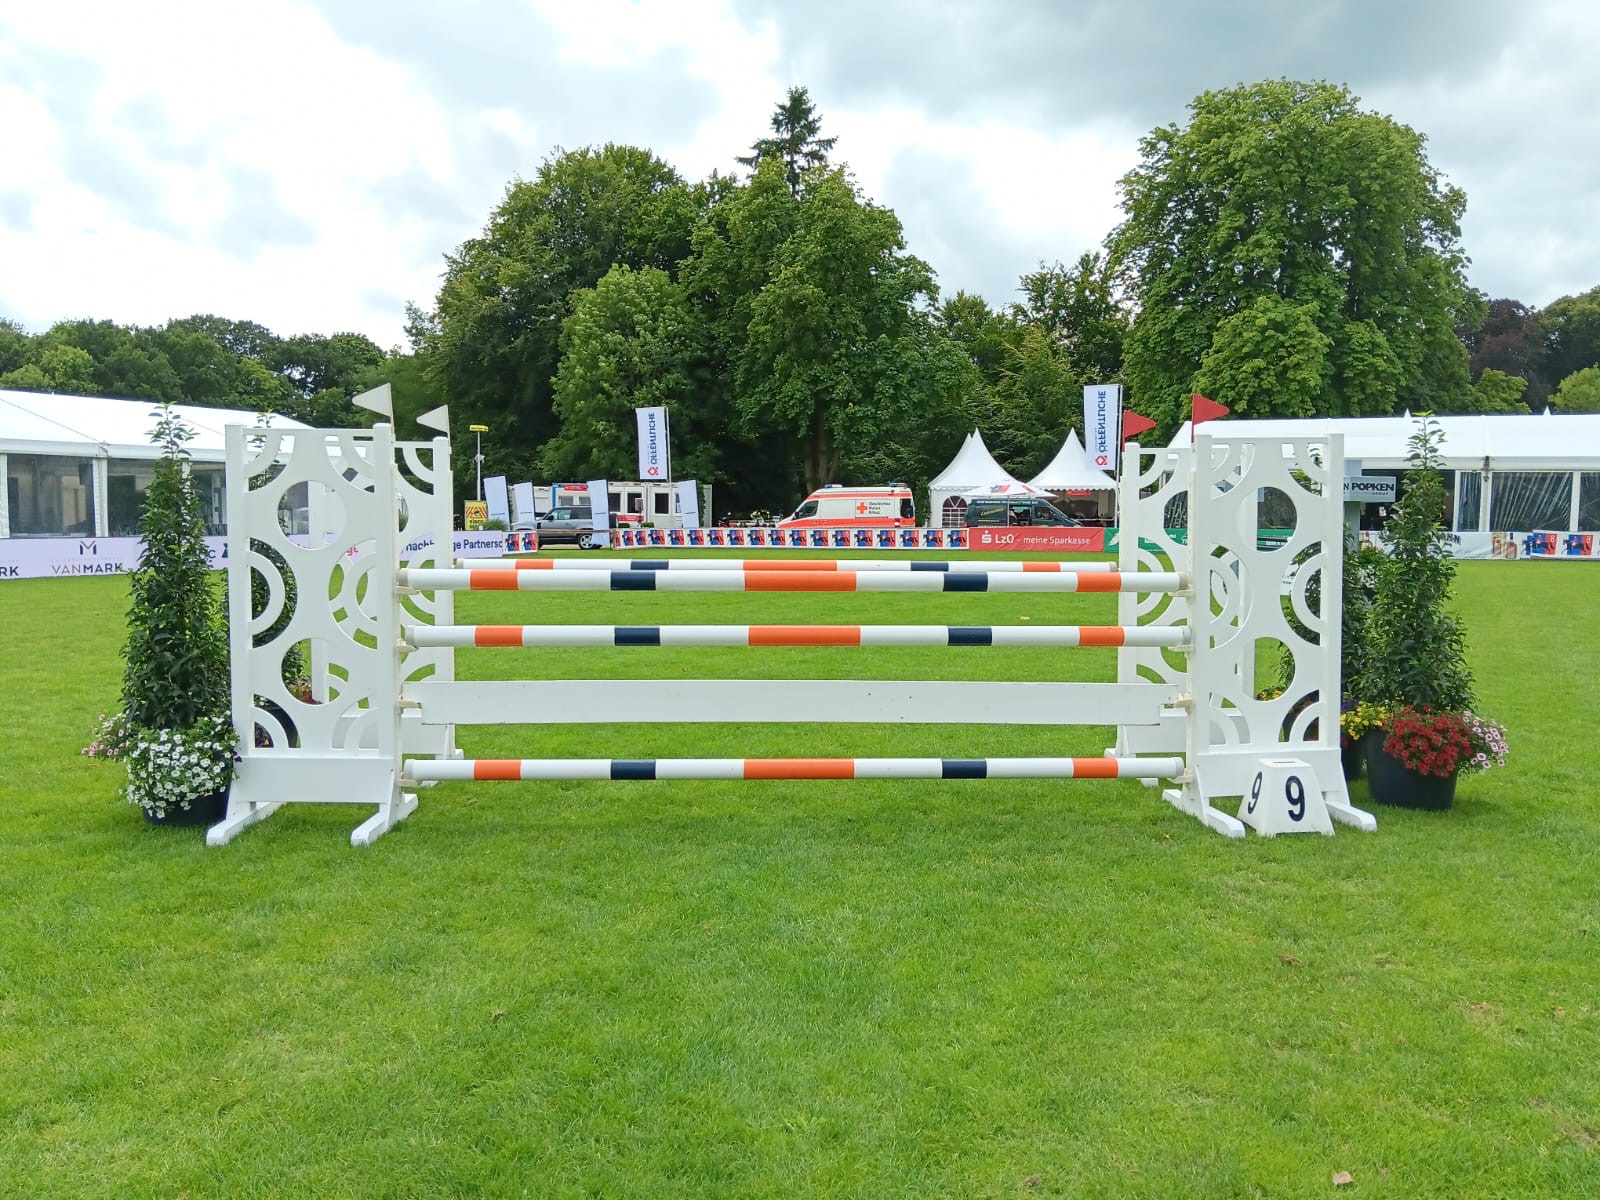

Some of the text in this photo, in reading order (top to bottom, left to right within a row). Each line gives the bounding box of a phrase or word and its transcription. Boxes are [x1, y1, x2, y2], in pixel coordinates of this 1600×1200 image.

[1351, 482, 1394, 491] POPKEN
[1023, 535, 1048, 545] meine
[1050, 534, 1091, 546] Sparkasse
[51, 562, 123, 574] VANMARK
[1247, 771, 1263, 815] 9
[1285, 775, 1305, 822] 9
